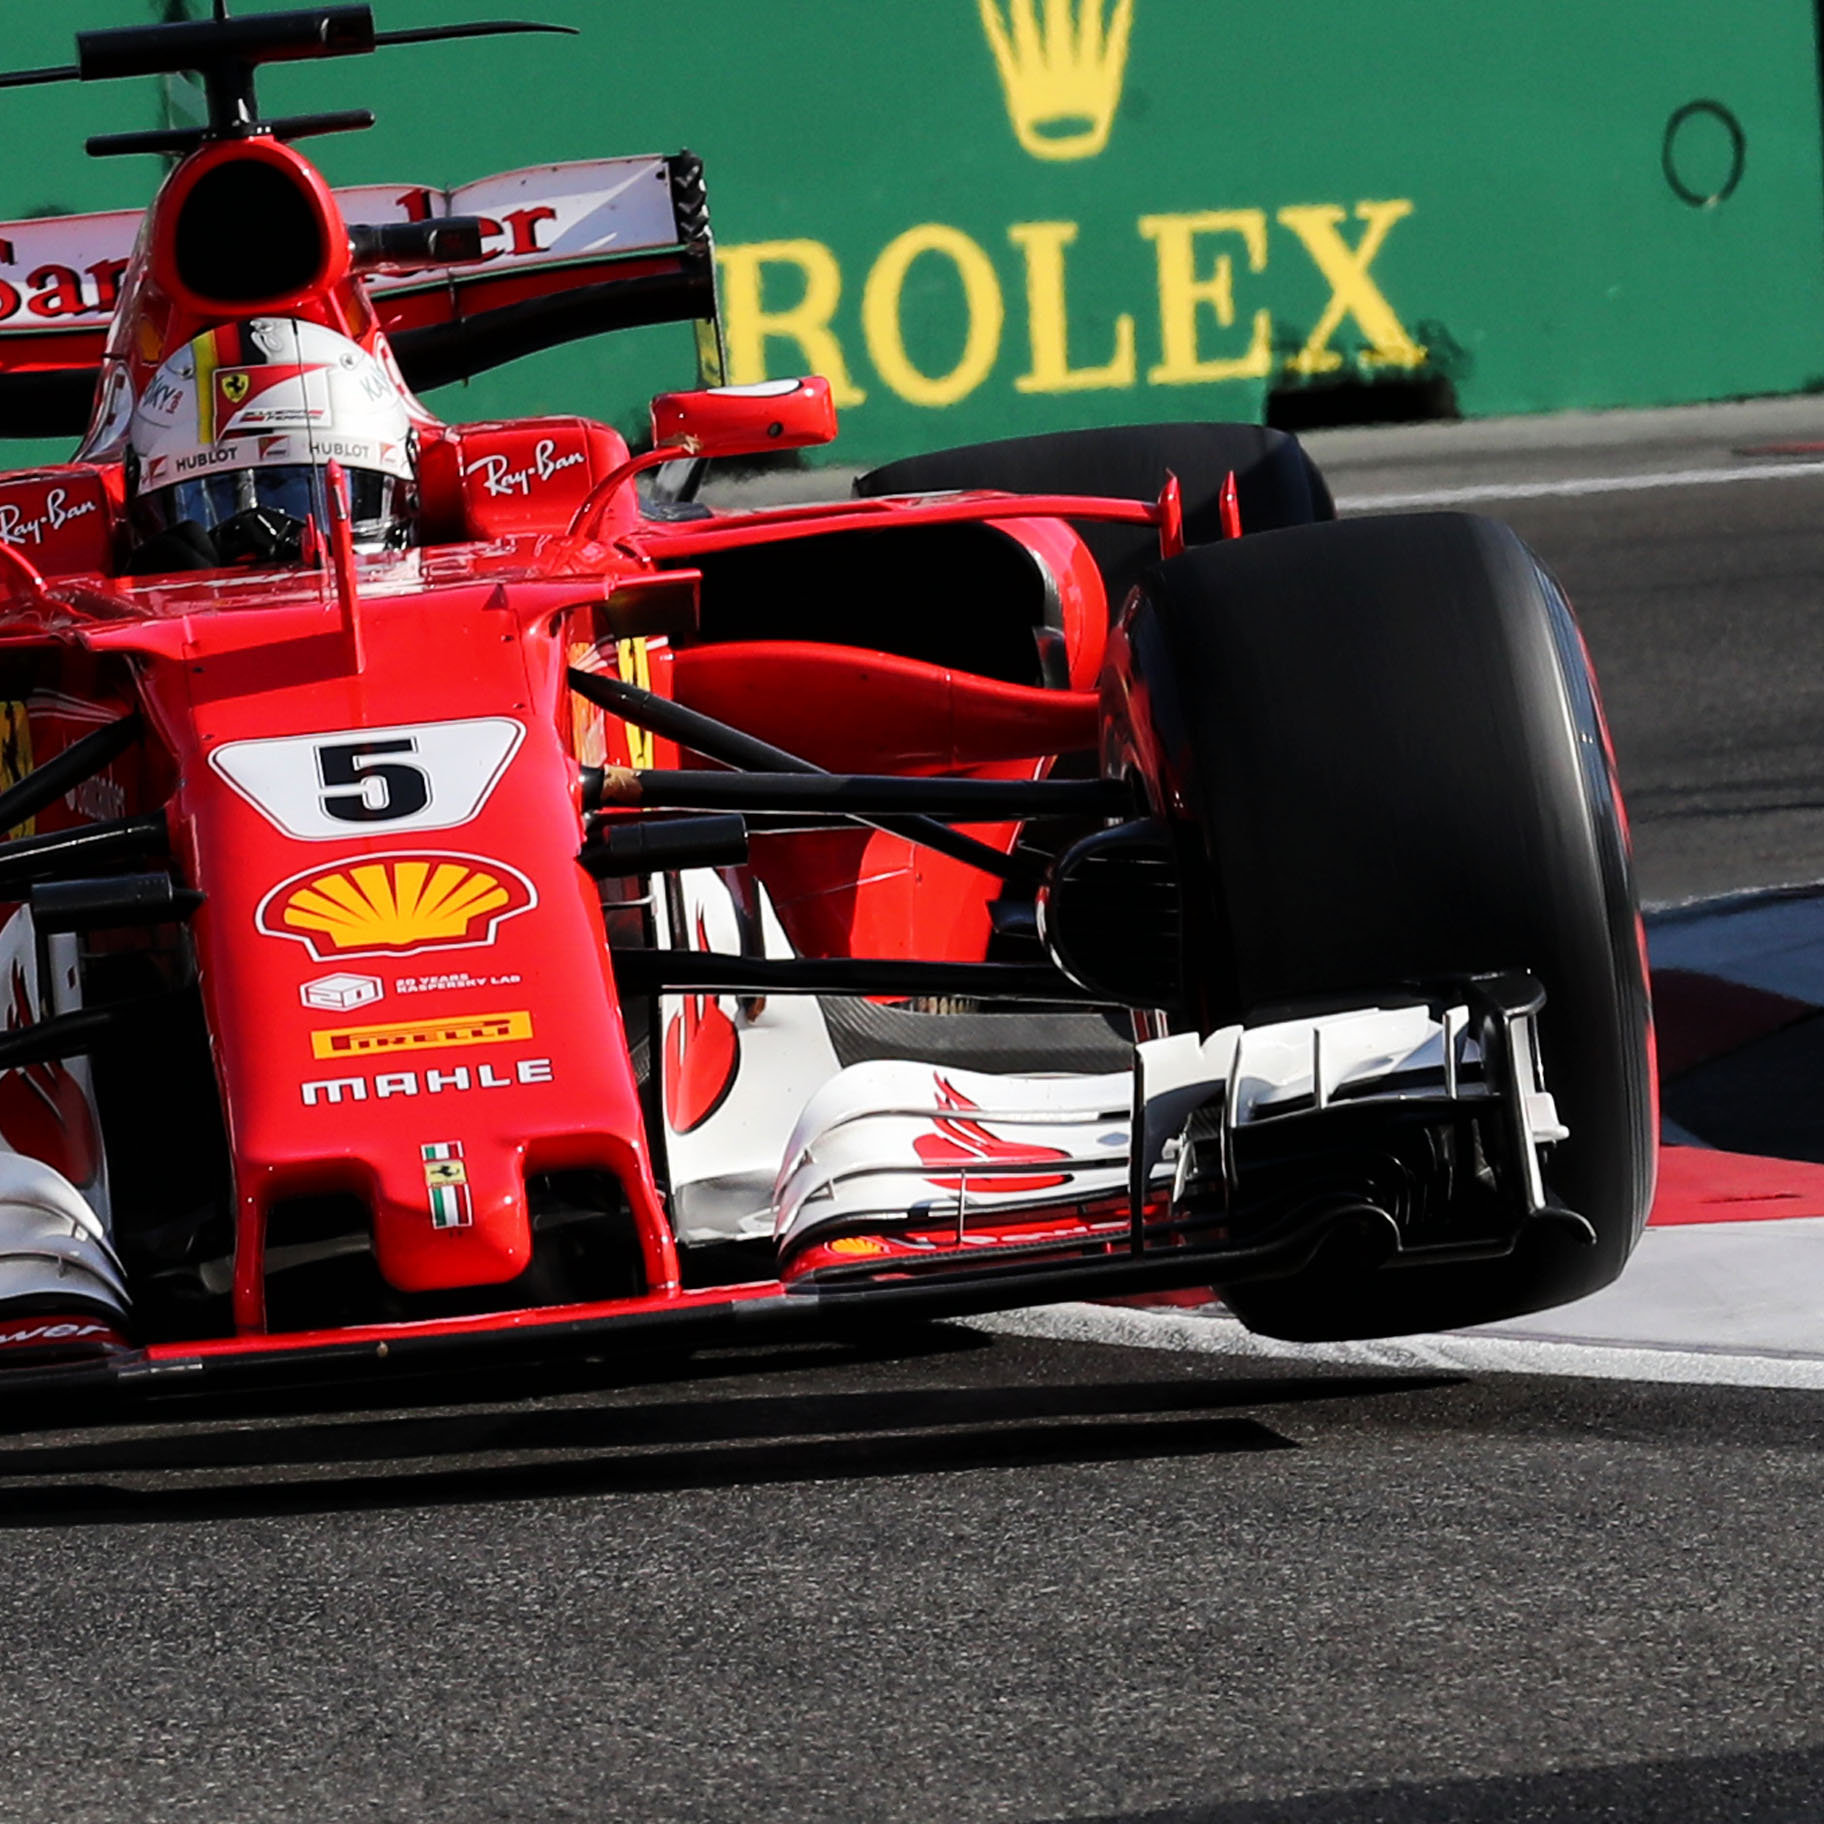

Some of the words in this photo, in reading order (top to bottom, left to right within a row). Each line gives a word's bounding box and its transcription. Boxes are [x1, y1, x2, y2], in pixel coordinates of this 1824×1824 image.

[715, 198, 1428, 407] ROLEX
[177, 447, 237, 473] HUBLOT
[309, 440, 371, 458] HUBLOT
[313, 737, 433, 822] 5
[396, 978, 486, 994] KASPERSKY
[491, 975, 521, 985] LAB
[419, 973, 469, 984] YEARS
[330, 1018, 511, 1052] PIRELLI
[300, 1057, 554, 1106] MAHLE
